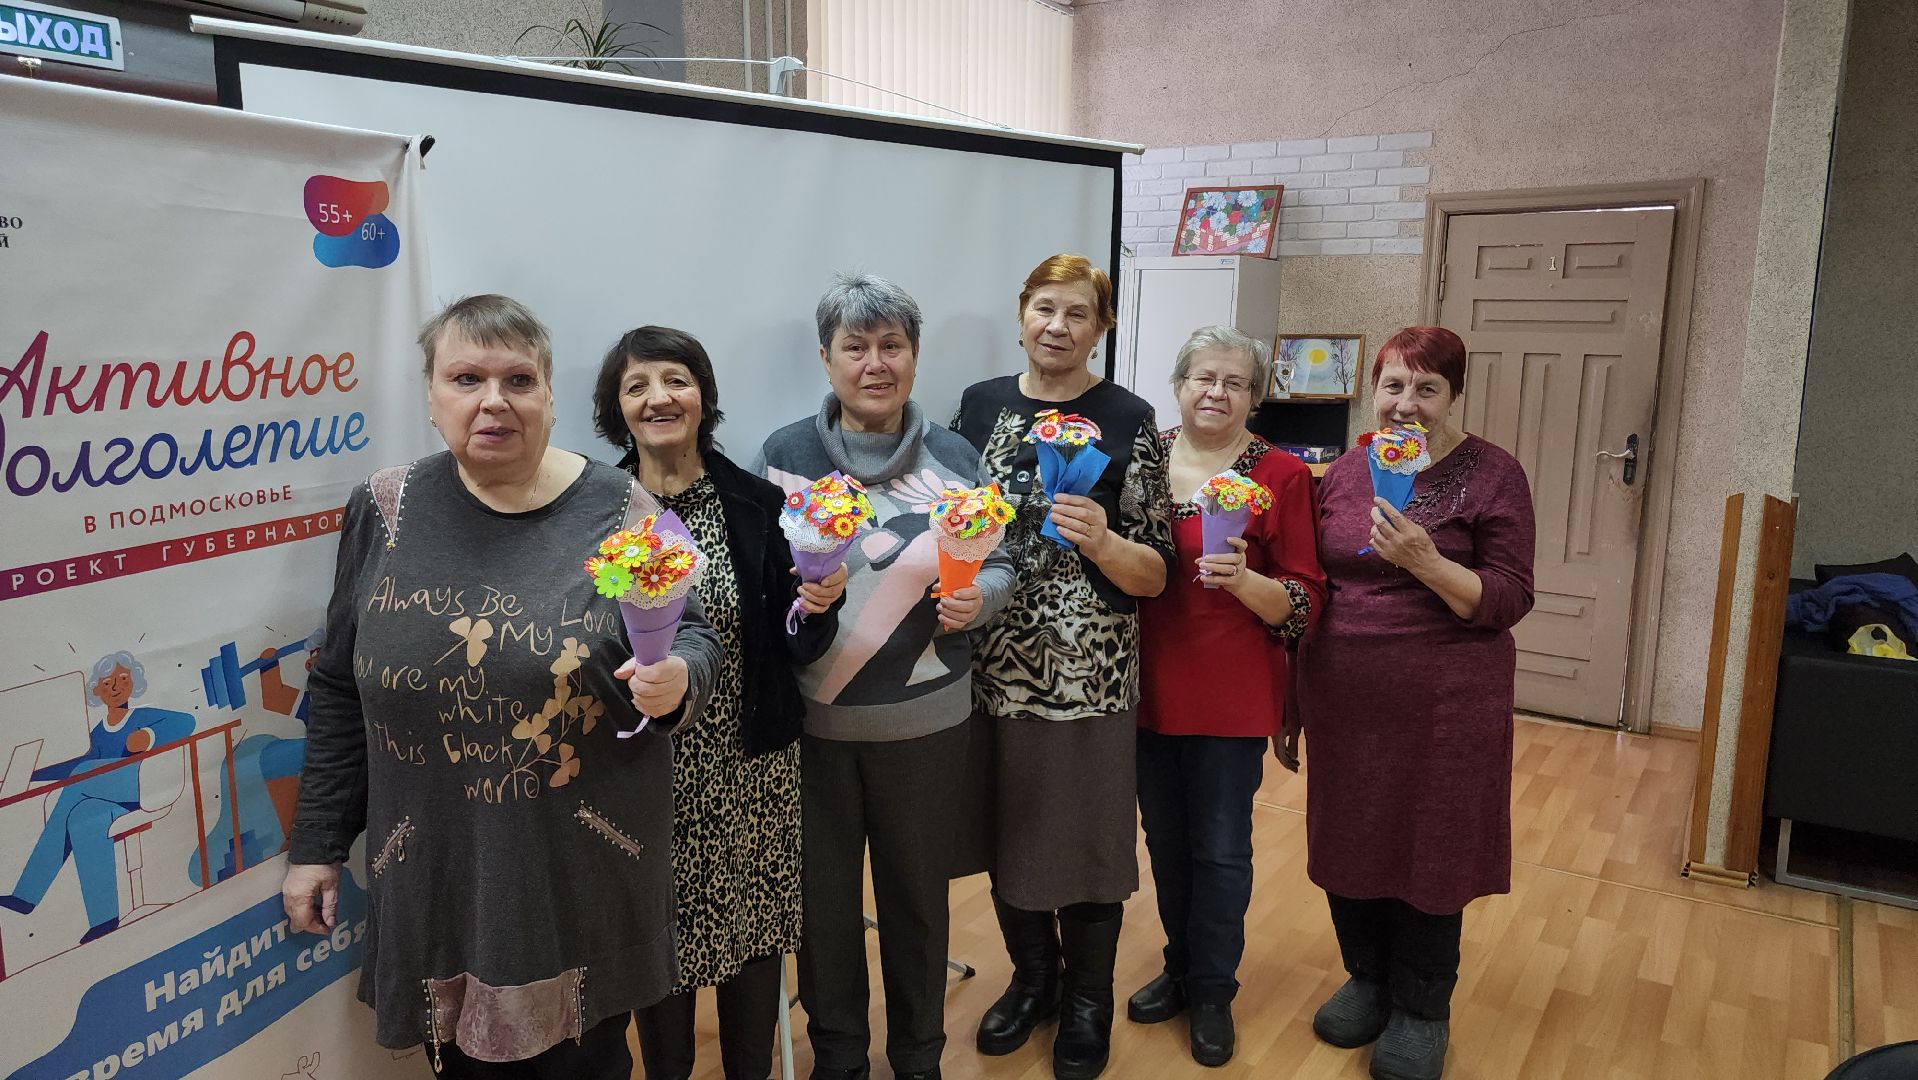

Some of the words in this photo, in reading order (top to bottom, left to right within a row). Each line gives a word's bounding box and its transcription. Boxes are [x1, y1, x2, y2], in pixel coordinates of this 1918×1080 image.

[0, 12, 107, 57] ЫХОД
[318, 203, 353, 224] 55+
[361, 222, 386, 241] 60+
[1549, 256, 1557, 271] 1
[0, 330, 358, 418] Активное
[0, 411, 370, 496] олголетие
[84, 515, 97, 534] В
[110, 484, 293, 530] ПОДМОСКОВЬЕ
[161, 513, 343, 562] ГУБЕРНАТОР
[366, 576, 465, 616] Always
[475, 584, 524, 617] Be
[499, 620, 553, 656] My
[560, 597, 618, 636] Love
[381, 666, 428, 691] are
[438, 691, 530, 725] white
[371, 722, 426, 765] This
[144, 920, 289, 1013] Найдит
[216, 962, 286, 1026] для
